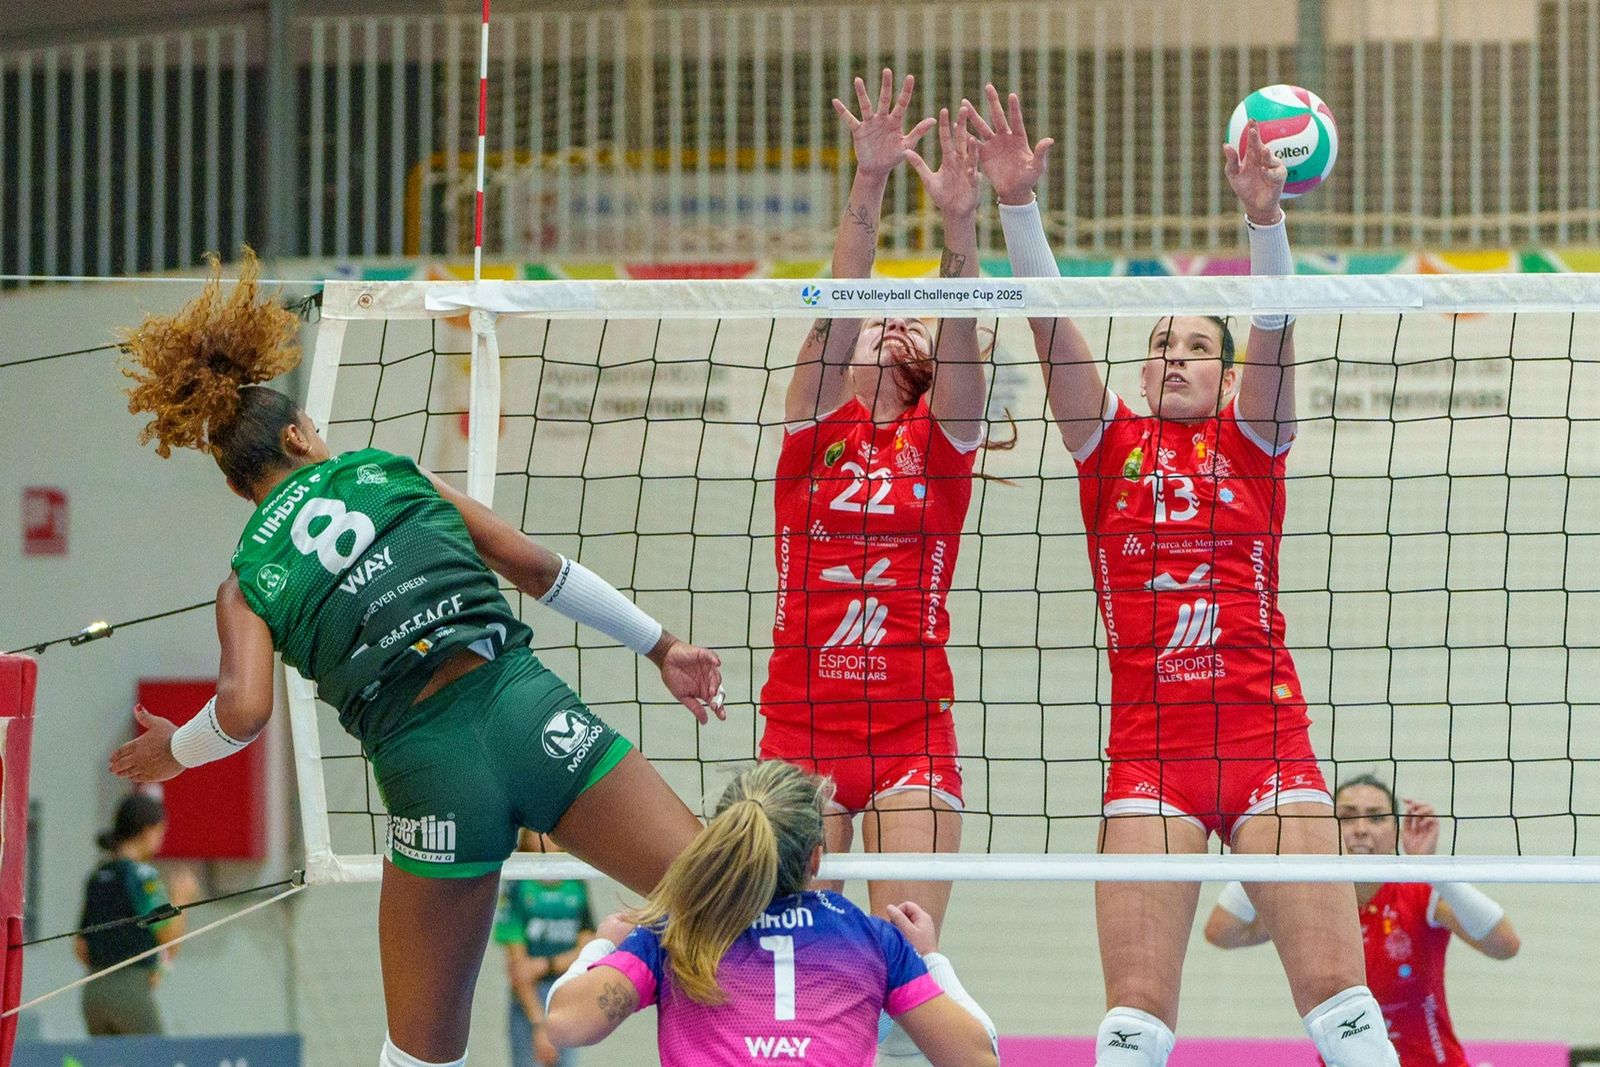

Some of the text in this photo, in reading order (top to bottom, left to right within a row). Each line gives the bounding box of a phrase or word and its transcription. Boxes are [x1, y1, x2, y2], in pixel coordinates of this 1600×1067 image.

[1274, 145, 1309, 159] olten
[831, 289, 1023, 302] CEV Volleyball Challenge Cup 2025
[829, 461, 895, 514] 22
[1143, 469, 1200, 523] 13
[290, 497, 376, 575] 8
[1182, 540, 1193, 548] de
[339, 546, 394, 594] WAY
[396, 575, 428, 594] GREEN
[818, 654, 887, 670] ESPORTS
[1156, 654, 1225, 674] ESPORTS
[818, 670, 887, 681] ILLES BALEARS
[1159, 669, 1226, 683] ILLES BALEARS
[759, 934, 796, 1021] 1
[744, 1036, 812, 1059] WAY
